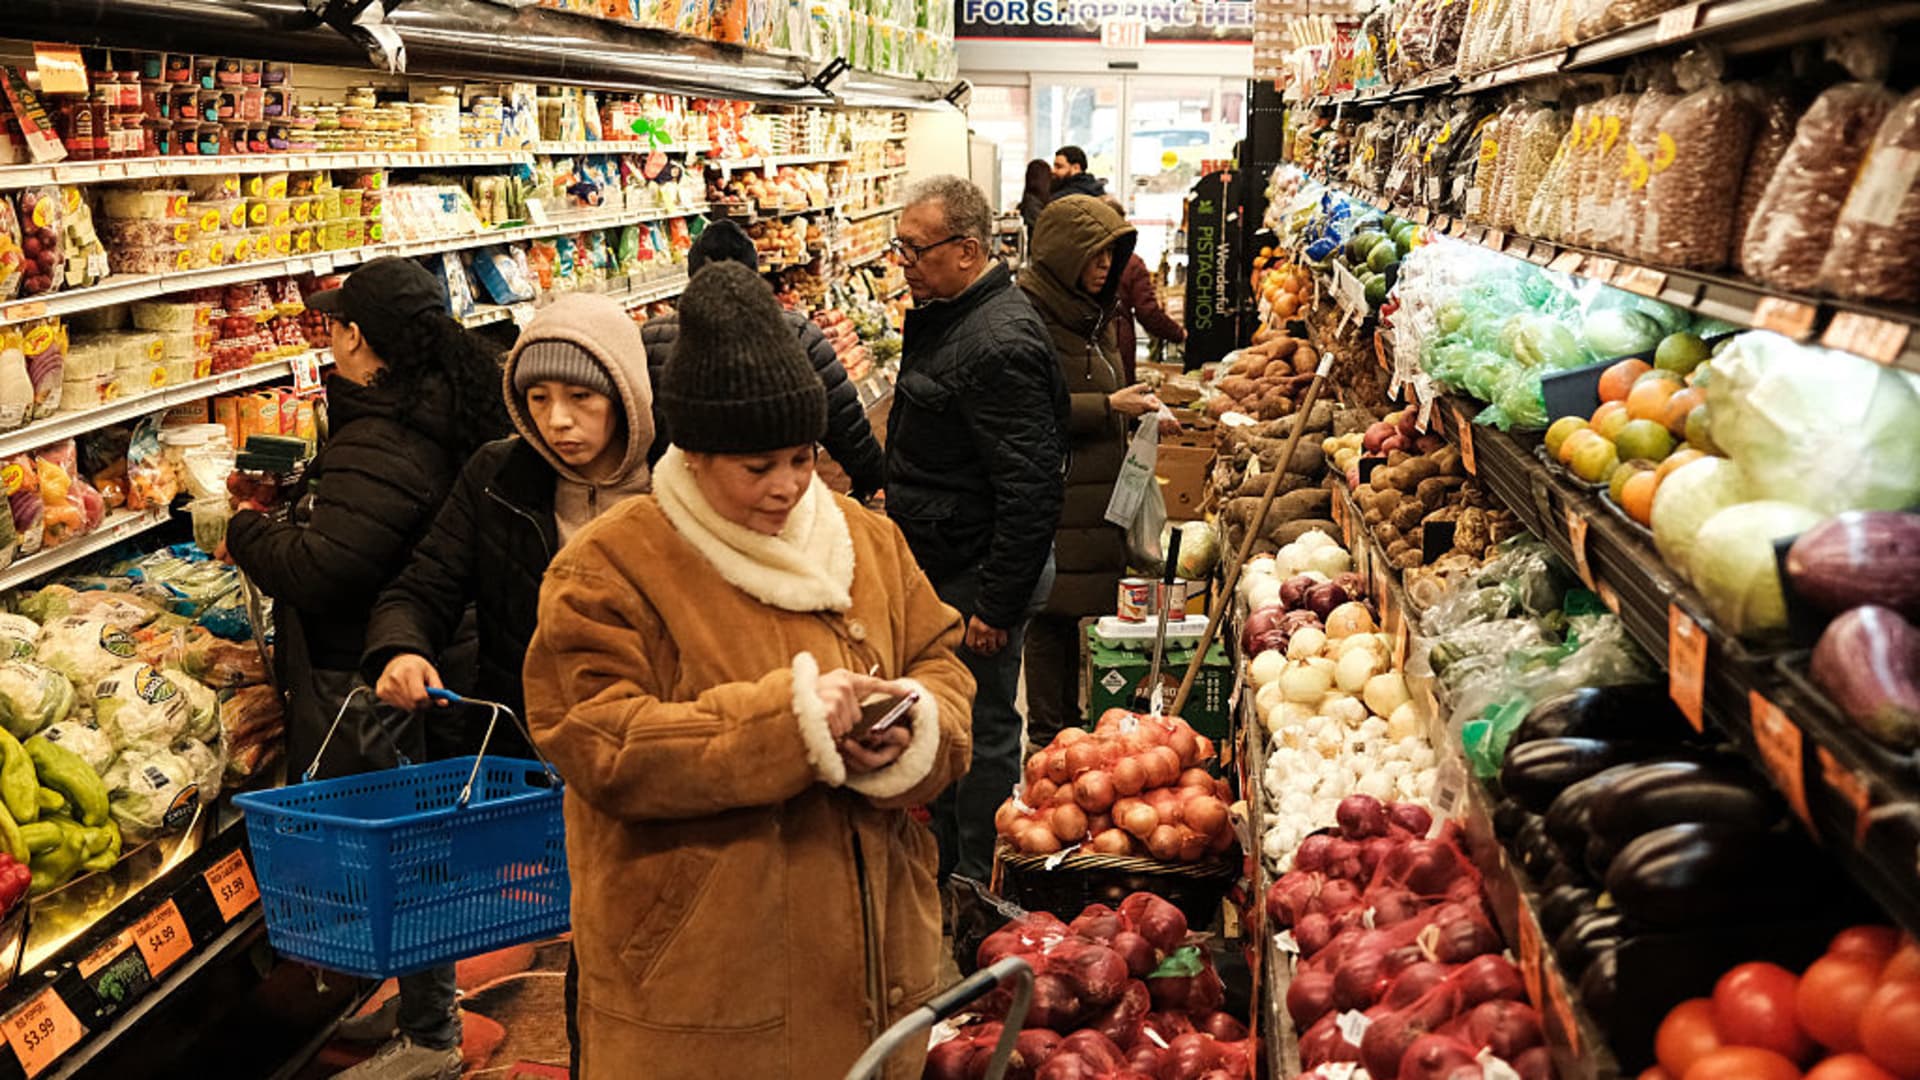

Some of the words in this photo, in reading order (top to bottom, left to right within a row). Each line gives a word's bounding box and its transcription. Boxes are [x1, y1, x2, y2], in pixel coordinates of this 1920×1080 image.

[965, 0, 1026, 22] FOR
[1037, 0, 1192, 24] SHOPPING
[1108, 22, 1141, 48] EXIT
[1195, 226, 1214, 329] PISTACHIOS
[149, 925, 176, 950] $4.99
[23, 1018, 56, 1050] $3.99
